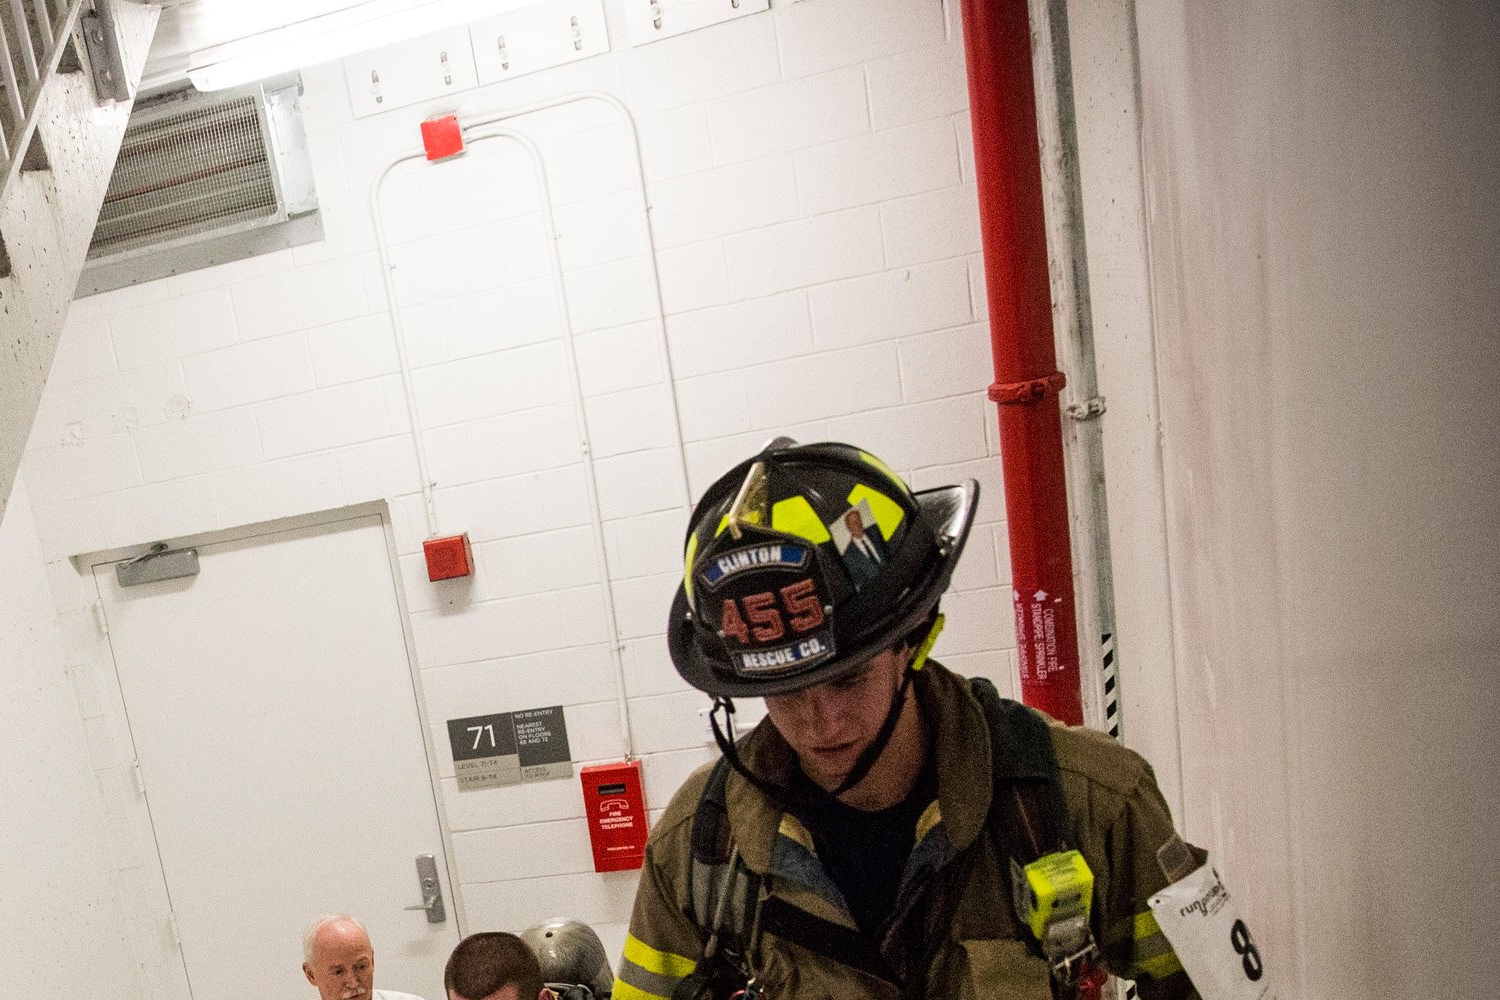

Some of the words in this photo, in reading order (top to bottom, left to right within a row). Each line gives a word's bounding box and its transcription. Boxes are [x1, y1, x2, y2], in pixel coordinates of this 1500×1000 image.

[718, 546, 781, 574] CLINTON
[721, 578, 825, 644] 455
[742, 648, 796, 668] RESCUE
[467, 724, 496, 750] 71
[600, 816, 634, 824] EMERGENCY
[601, 822, 634, 830] TELEPHONE
[1230, 919, 1263, 982] 8
